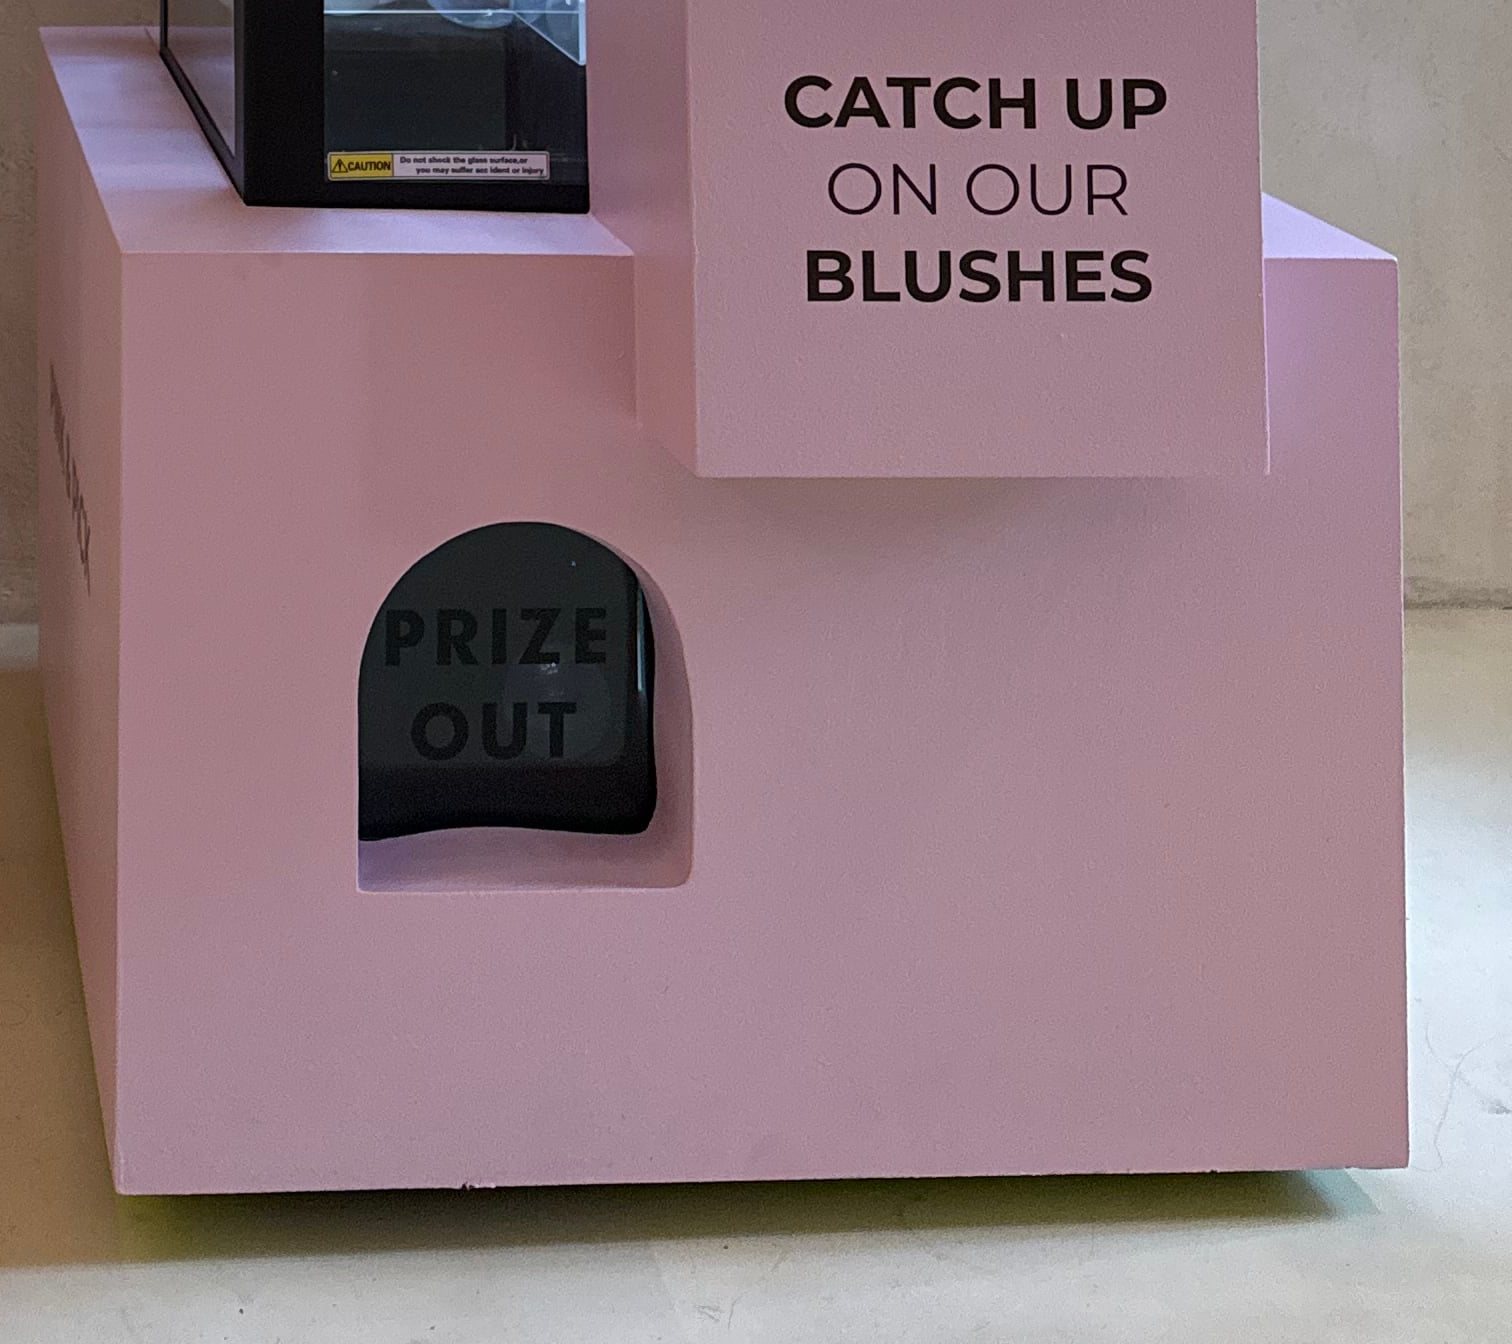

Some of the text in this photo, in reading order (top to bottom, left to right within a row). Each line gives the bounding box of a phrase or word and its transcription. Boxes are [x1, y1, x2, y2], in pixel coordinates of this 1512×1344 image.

[784, 75, 1167, 130] CATCH UP
[347, 161, 392, 171] CAUTION
[399, 156, 411, 164] Do
[413, 156, 426, 164] not
[428, 156, 451, 164] shock
[453, 156, 466, 164] the
[467, 156, 488, 165] glass
[416, 167, 431, 175] you
[432, 167, 449, 175] may
[451, 166, 473, 174] suffer
[521, 166, 544, 175] injury
[828, 163, 1128, 216] ON OUR
[806, 250, 1152, 303] BLUSHES
[384, 607, 607, 666] PRIZE
[410, 701, 578, 760] OUT
